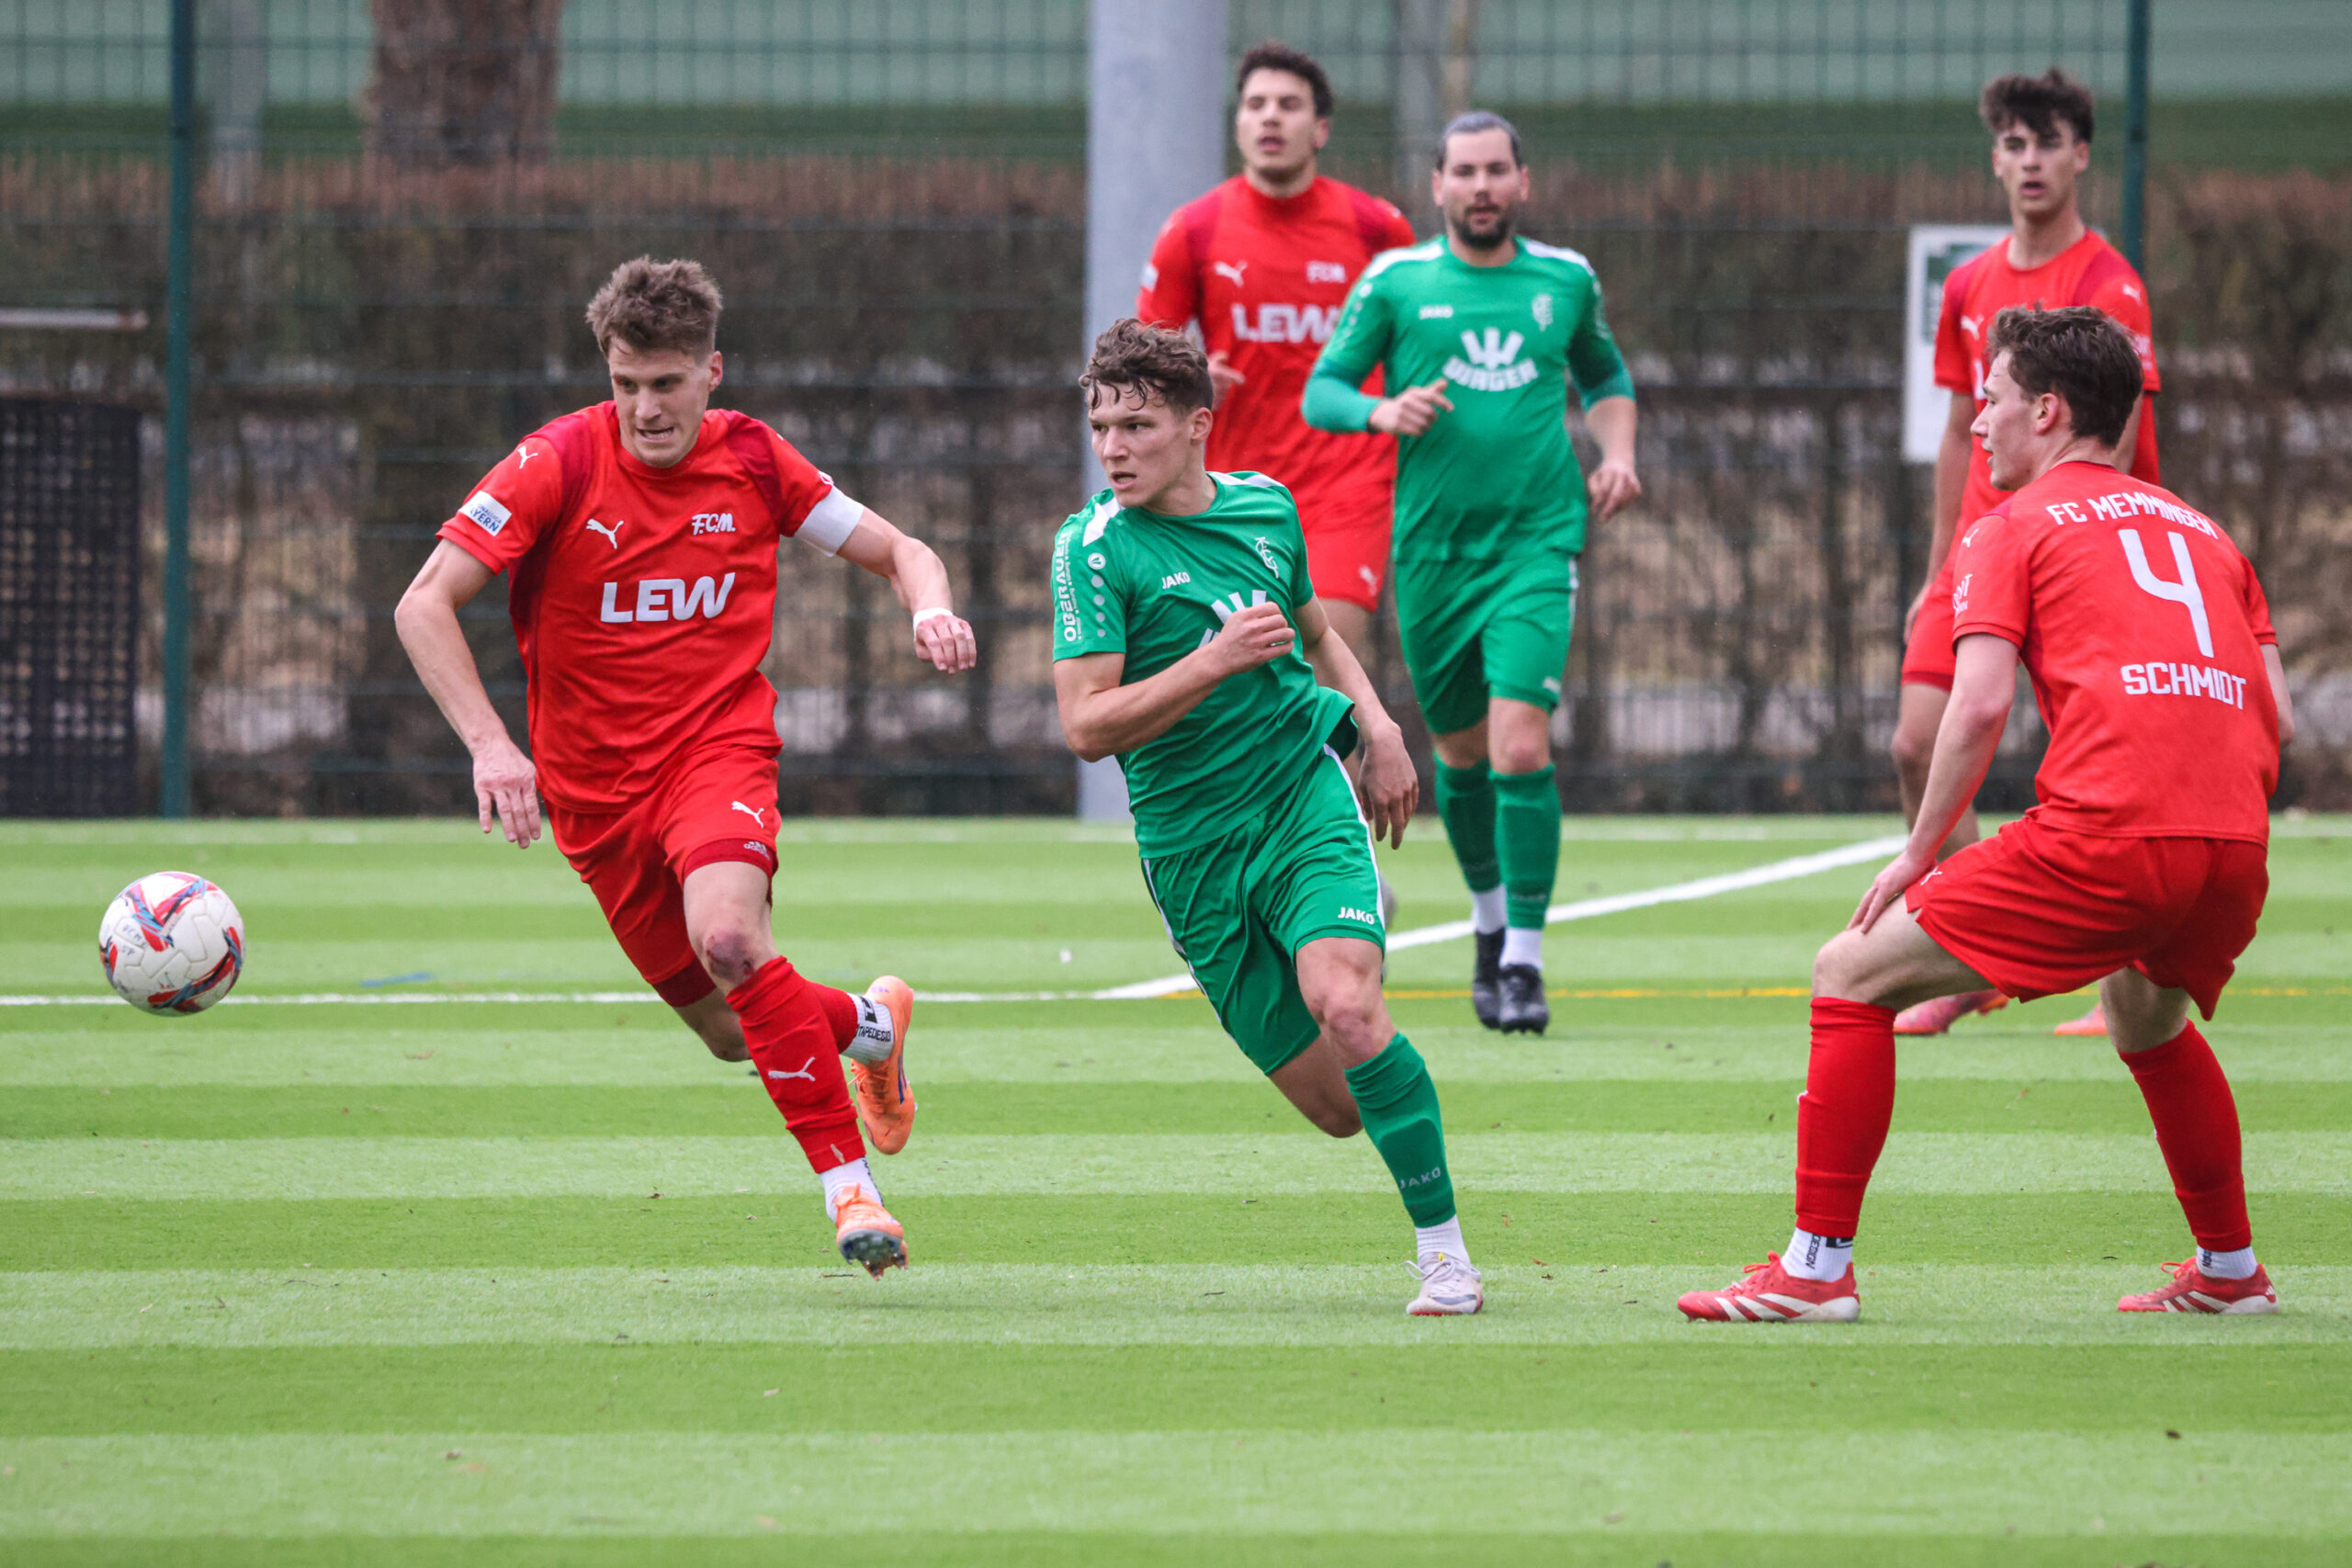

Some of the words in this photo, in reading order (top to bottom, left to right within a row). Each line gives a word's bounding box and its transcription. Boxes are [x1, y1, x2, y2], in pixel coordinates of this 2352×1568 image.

[1231, 302, 1341, 344] LEW
[2045, 502, 2088, 525] FC
[2086, 491, 2219, 540] MEMMINGEN
[600, 572, 736, 624] LEW
[1056, 532, 1078, 642] OBERAUER
[1161, 571, 1192, 590] JAKO
[2118, 528, 2214, 659] 4
[2120, 661, 2247, 710] SCHMIDT
[1338, 906, 1375, 925] JAKO
[1399, 1167, 1442, 1190] JAKO
